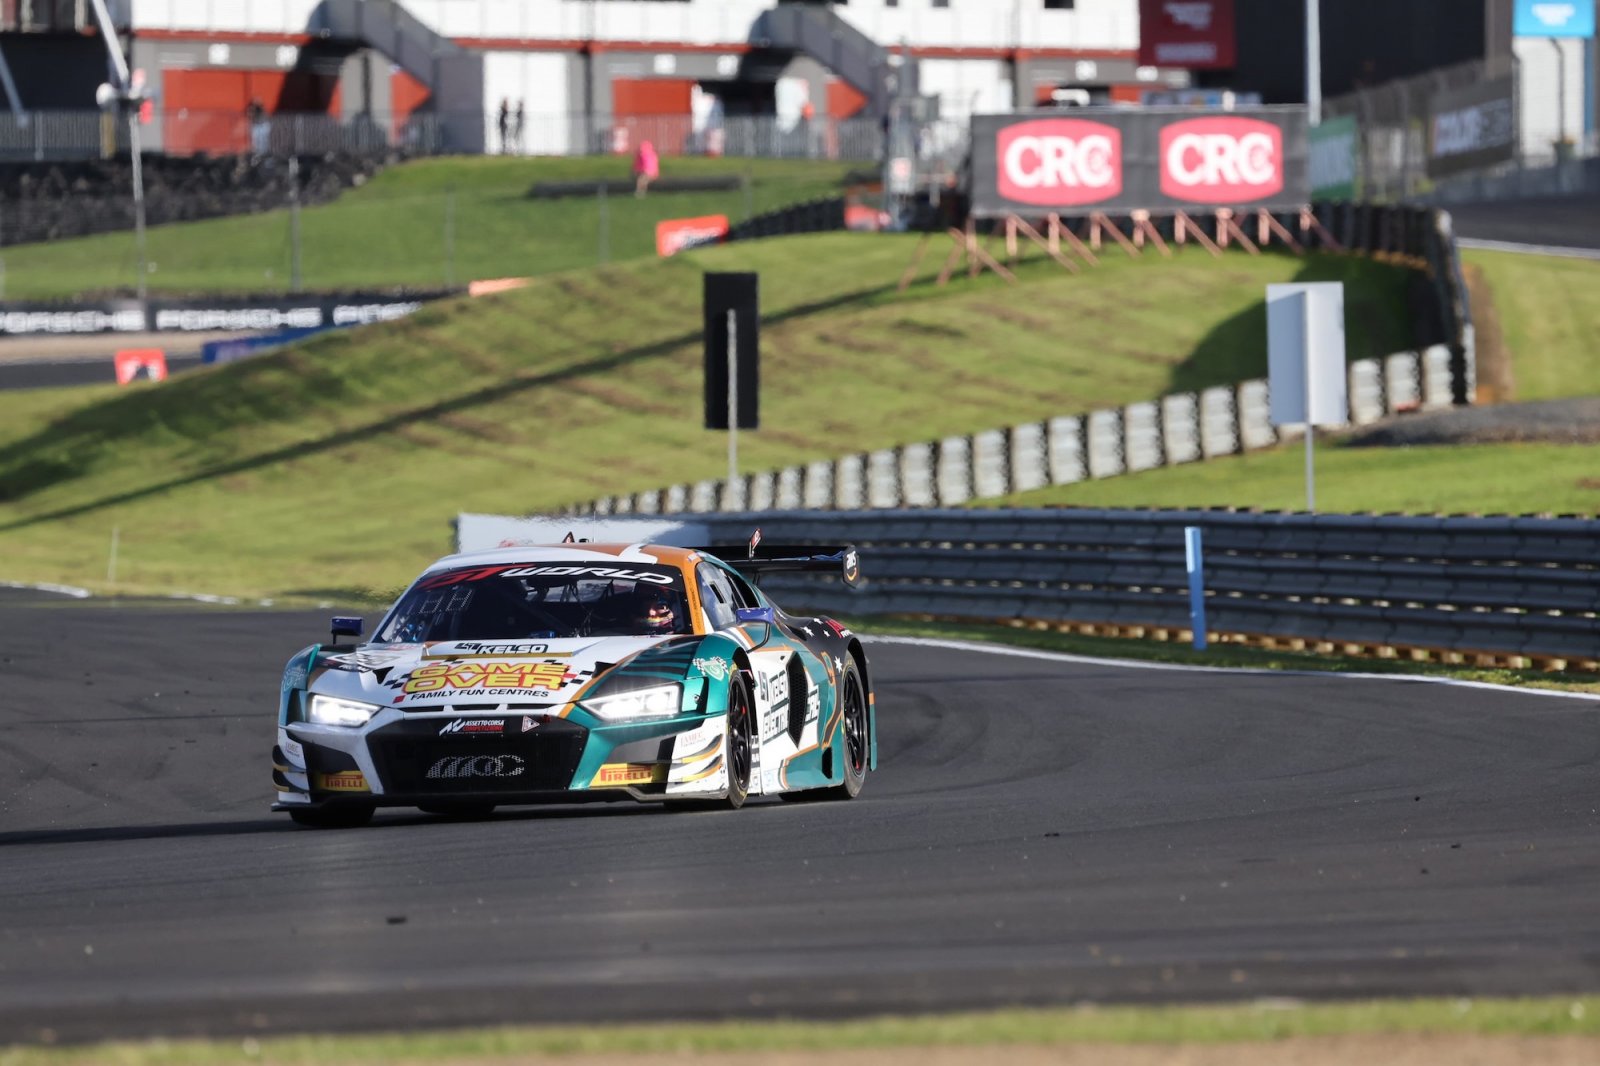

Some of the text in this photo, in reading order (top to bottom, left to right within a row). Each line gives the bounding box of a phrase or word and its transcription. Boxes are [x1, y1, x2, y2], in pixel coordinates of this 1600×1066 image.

[1004, 134, 1114, 188] CRC
[1167, 132, 1275, 186] CRC
[416, 564, 674, 591] GT WORLD
[476, 644, 549, 655] KELSO
[409, 662, 571, 679] GAME
[403, 673, 564, 694] OVER
[410, 690, 454, 701] FAMILY
[487, 688, 550, 698] CENTRES
[325, 774, 363, 788] PIRELLI
[600, 765, 653, 782] PIRELLI
